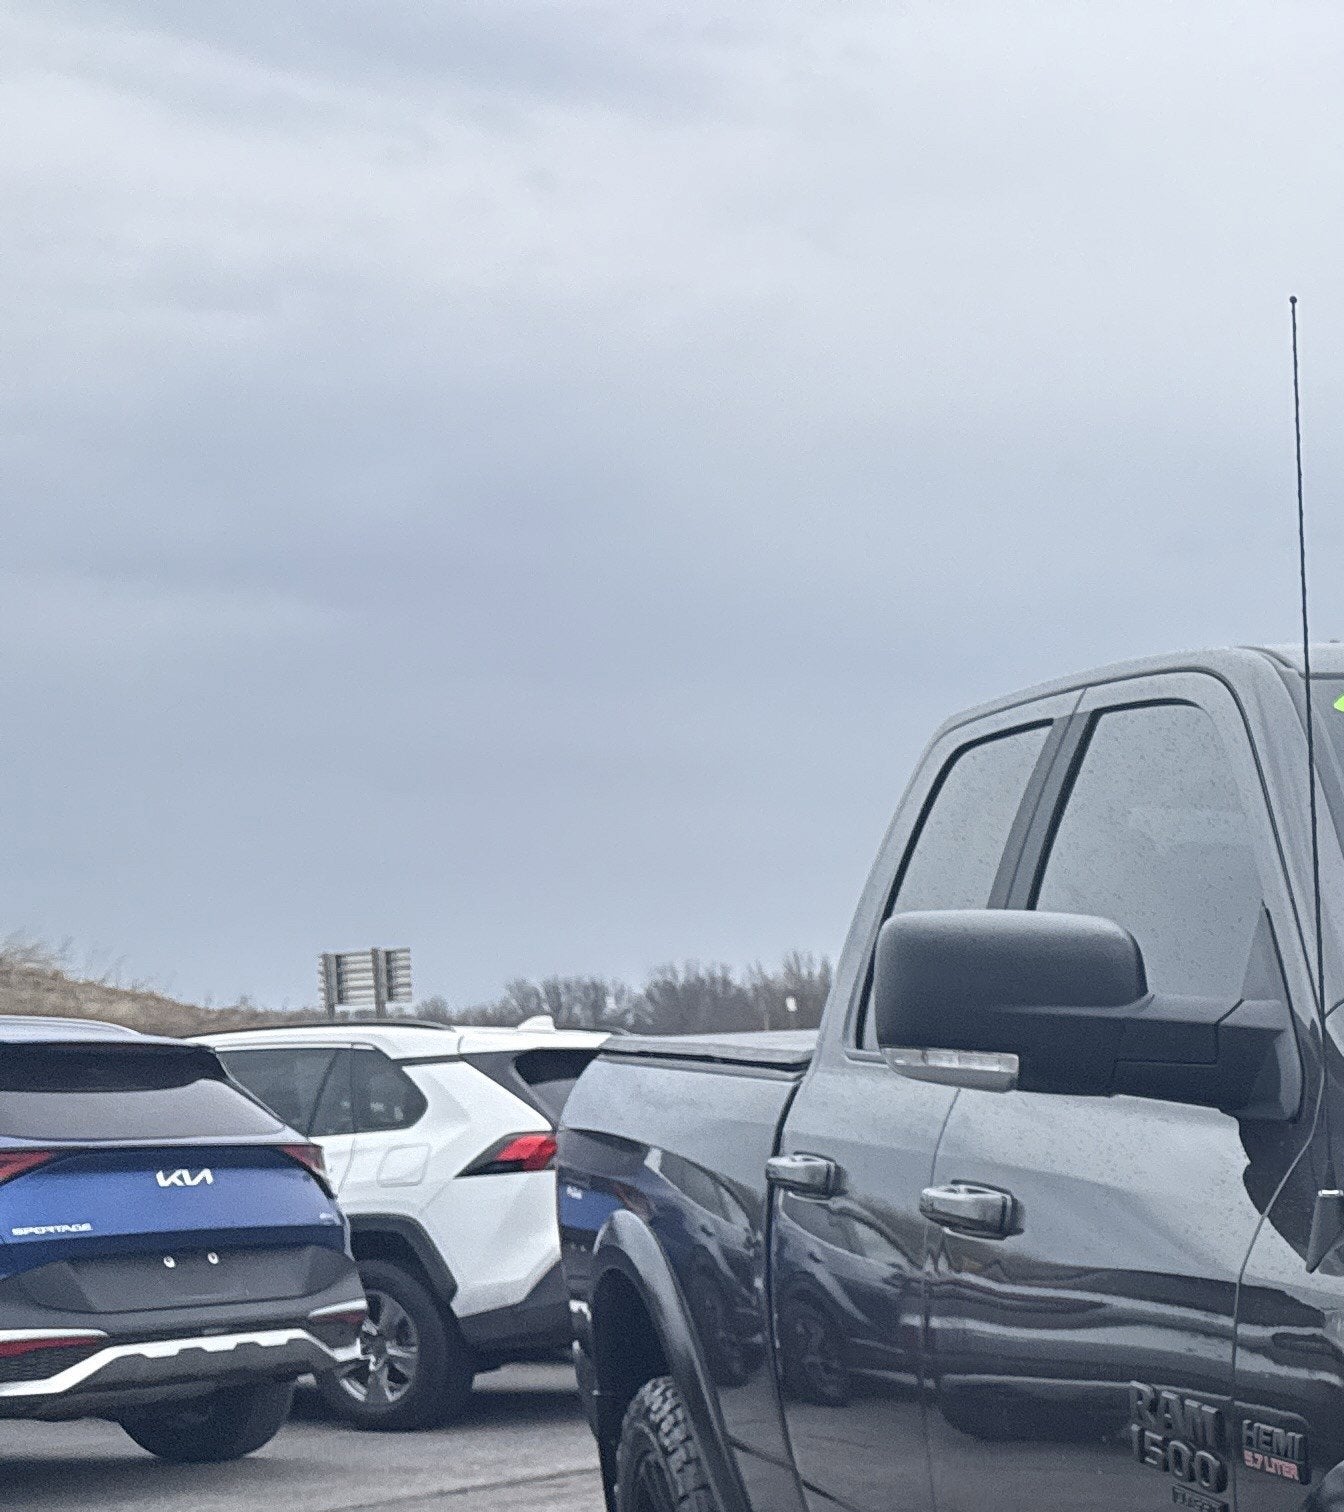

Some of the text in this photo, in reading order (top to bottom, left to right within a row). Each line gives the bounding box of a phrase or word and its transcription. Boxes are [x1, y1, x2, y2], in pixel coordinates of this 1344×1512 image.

[156, 1168, 214, 1188] KIA
[1130, 1380, 1223, 1447] RAM
[1130, 1423, 1228, 1494] 1500
[1242, 1419, 1303, 1461] HEMI
[1263, 1454, 1300, 1481] LITER
